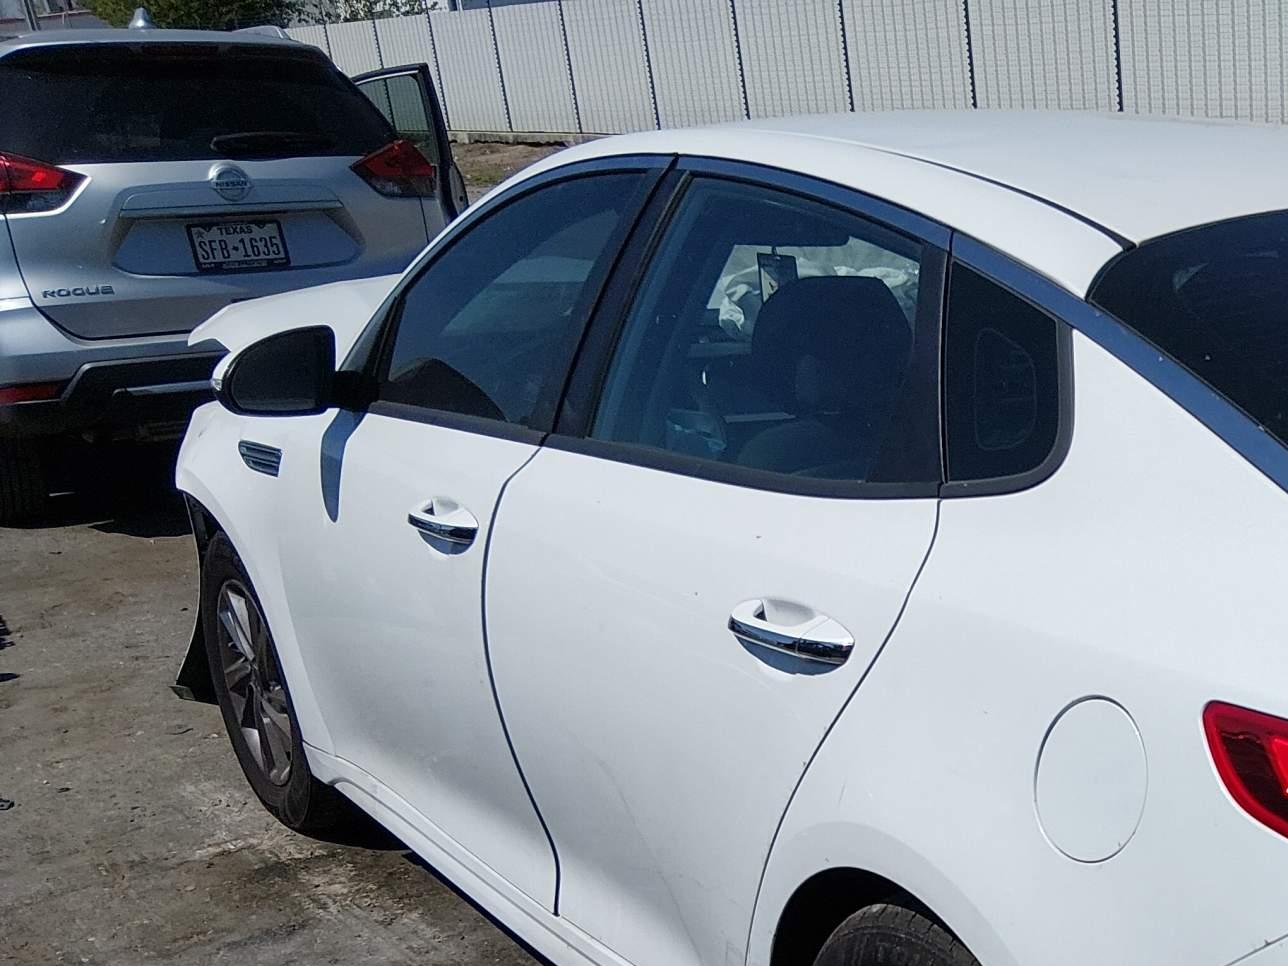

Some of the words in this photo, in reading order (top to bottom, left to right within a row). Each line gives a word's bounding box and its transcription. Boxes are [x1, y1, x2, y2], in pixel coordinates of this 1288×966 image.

[215, 180, 248, 188] NISSAN
[217, 225, 253, 236] TEXAS
[42, 284, 116, 299] ROGUE
